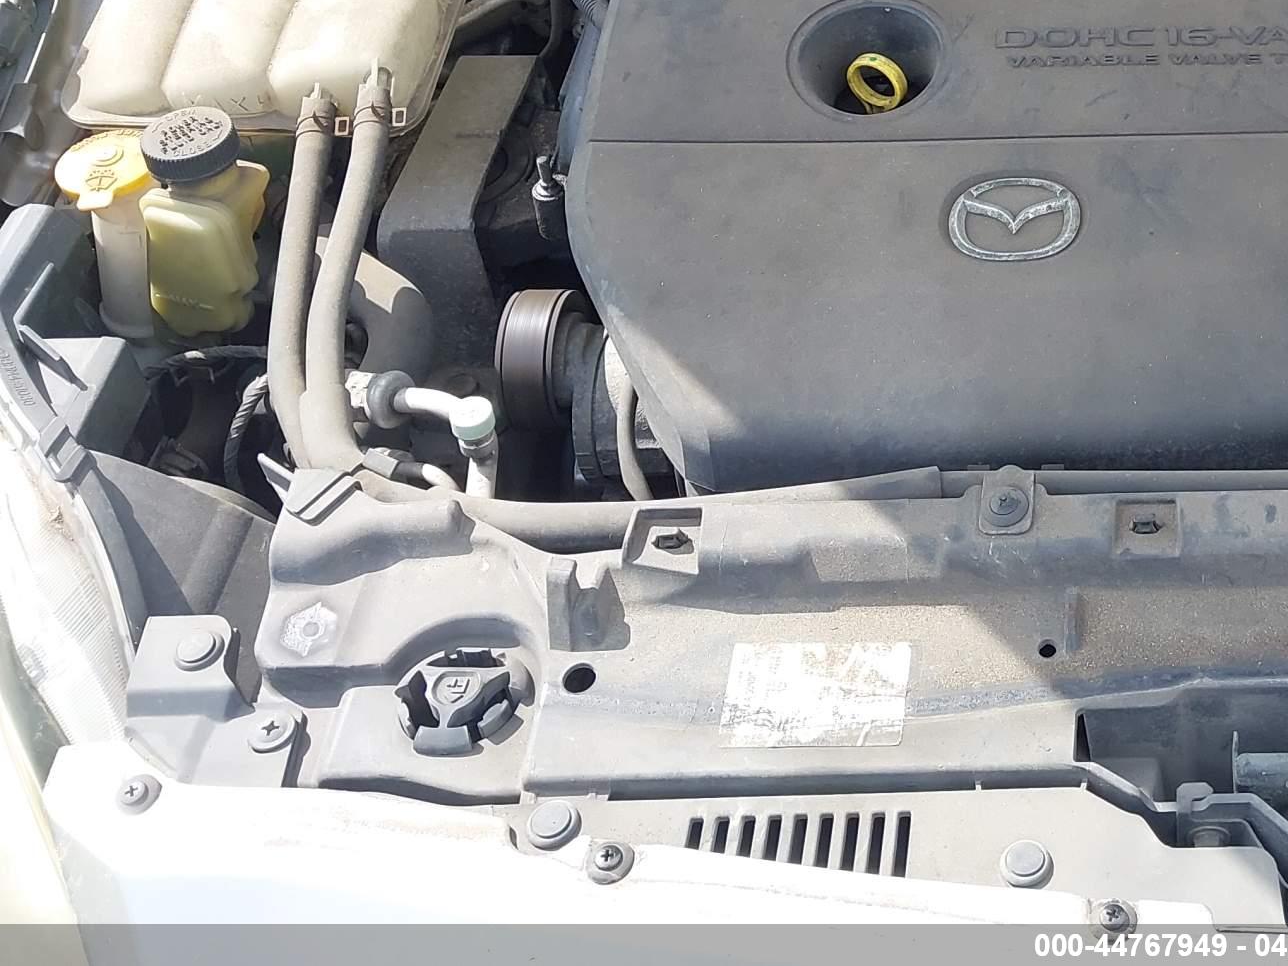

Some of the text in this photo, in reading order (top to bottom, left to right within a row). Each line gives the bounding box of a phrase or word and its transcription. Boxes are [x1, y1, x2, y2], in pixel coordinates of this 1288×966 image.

[995, 27, 1155, 49] DOHC
[1007, 54, 1160, 68] VARIABLE
[1168, 53, 1263, 66] VALVE
